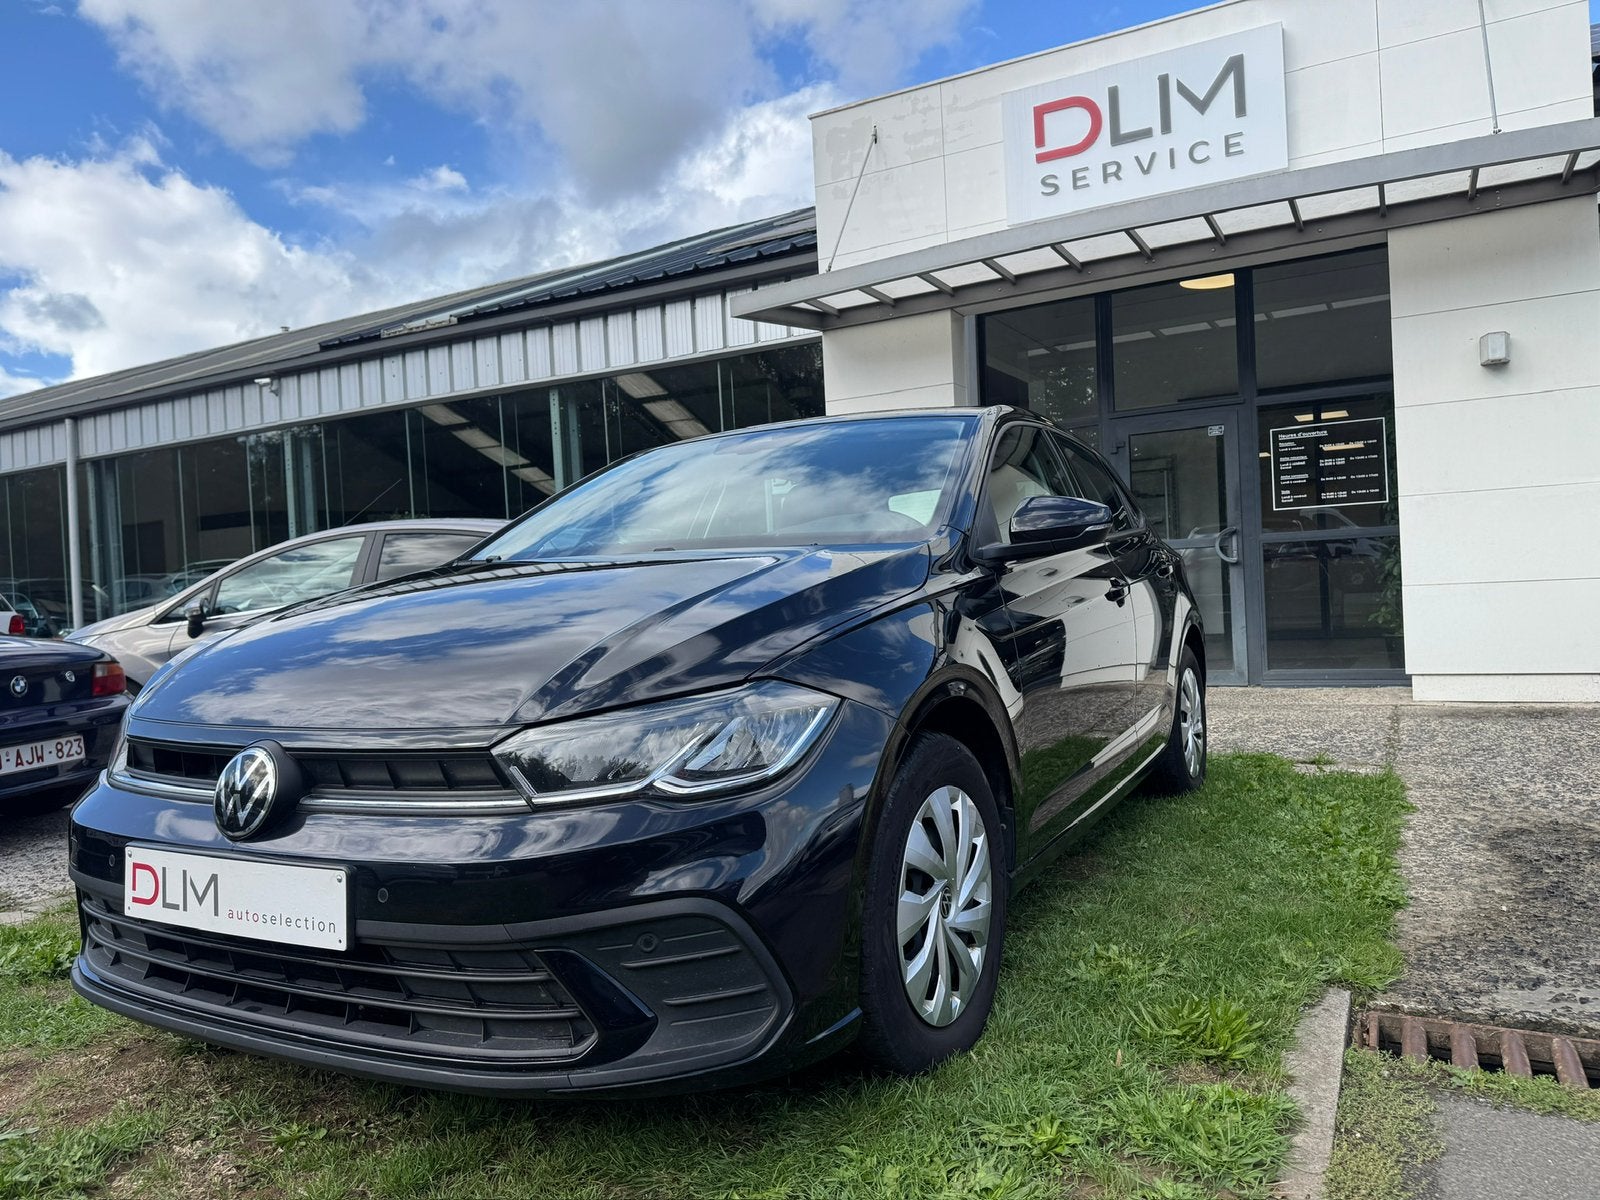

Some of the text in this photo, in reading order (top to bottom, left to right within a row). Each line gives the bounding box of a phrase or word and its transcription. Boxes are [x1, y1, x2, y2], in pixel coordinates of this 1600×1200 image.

[1033, 53, 1247, 164] DLM
[1040, 131, 1245, 197] SERVICE
[131, 862, 219, 917] DLM
[227, 908, 336, 933] autoselection
